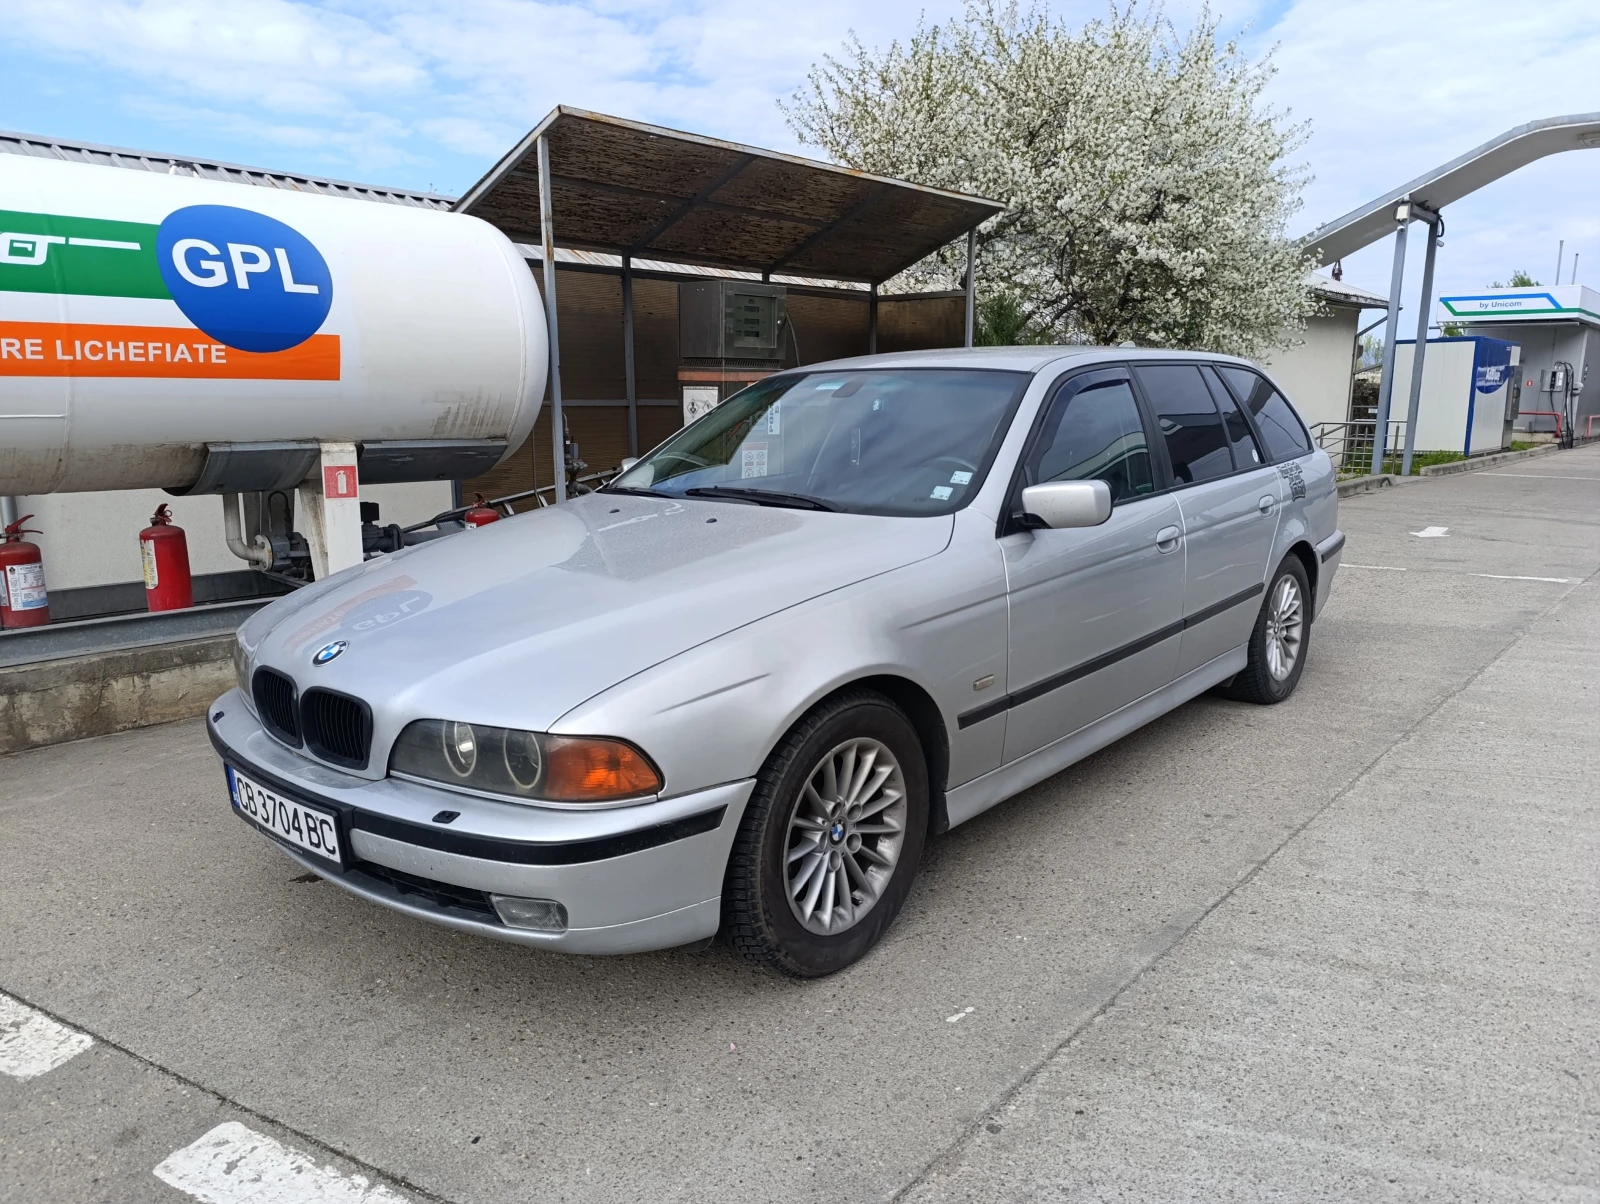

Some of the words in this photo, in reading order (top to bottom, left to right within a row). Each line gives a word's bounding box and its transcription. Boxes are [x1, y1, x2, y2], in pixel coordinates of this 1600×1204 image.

[172, 238, 320, 295] GPL
[1479, 301, 1489, 309] by
[55, 339, 227, 364] LICHEFIATE
